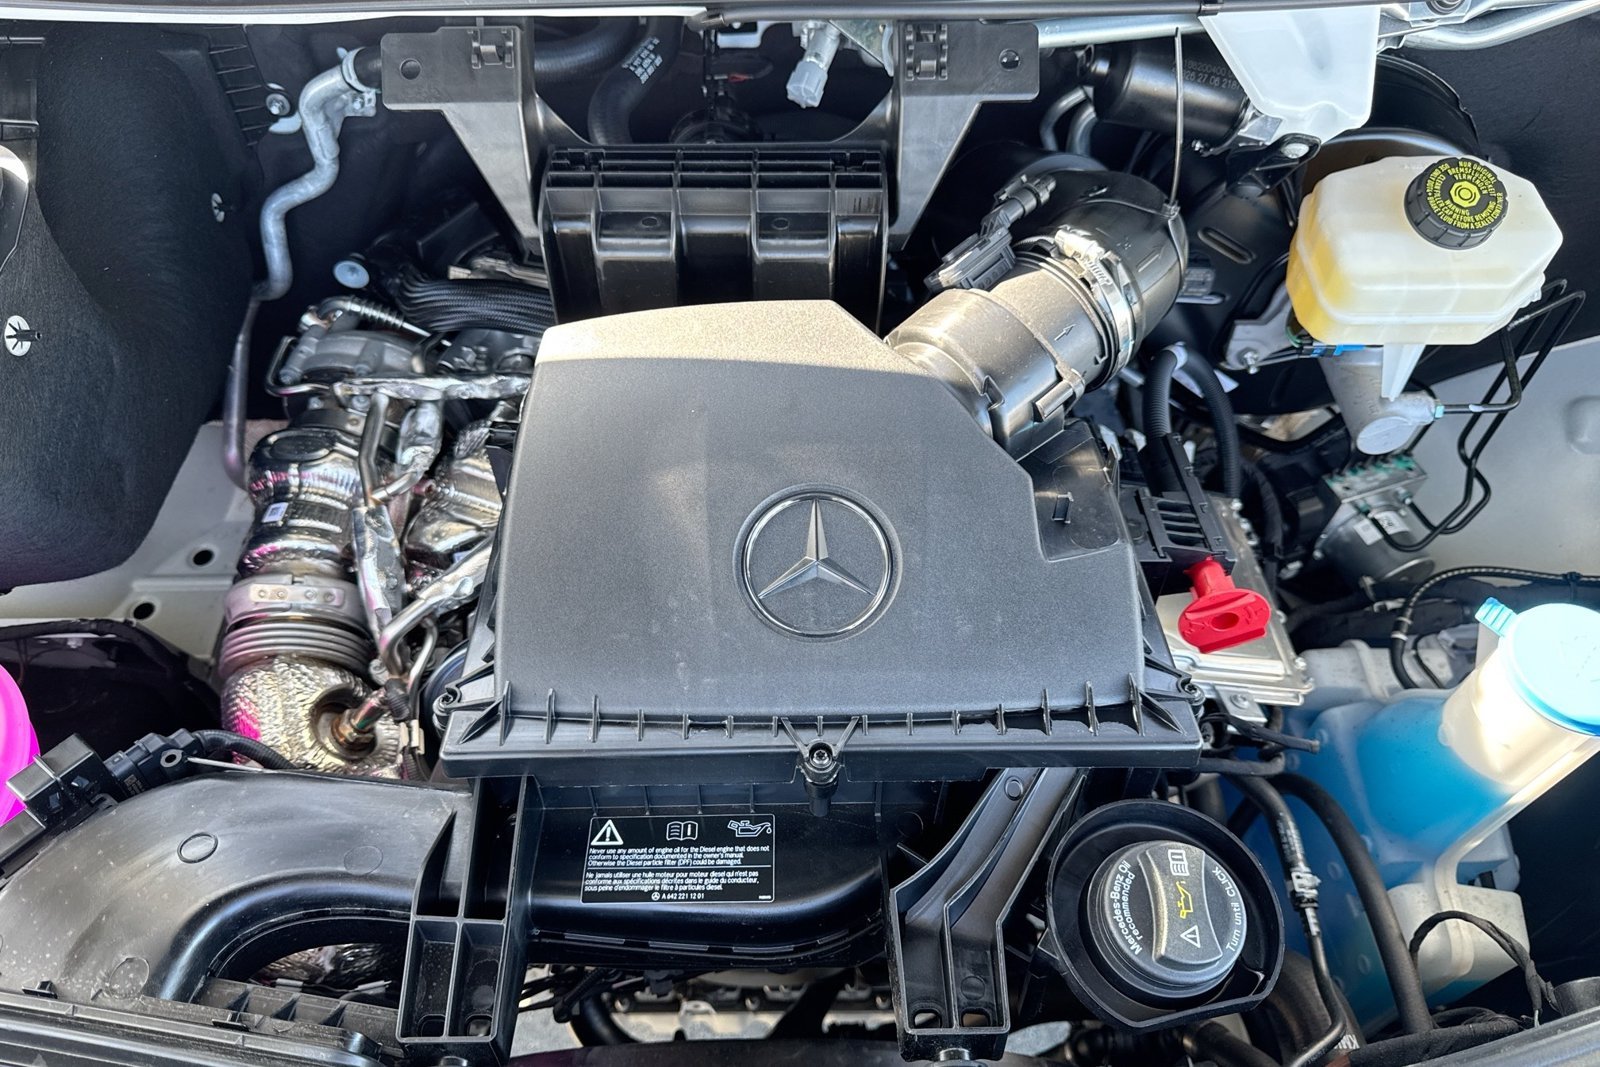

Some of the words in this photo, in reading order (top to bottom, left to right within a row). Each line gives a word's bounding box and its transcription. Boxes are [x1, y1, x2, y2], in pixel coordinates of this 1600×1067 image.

[1472, 163, 1497, 184] ORIGINAL
[1444, 200, 1470, 216] WARNING
[1118, 860, 1132, 874] Oil
[1212, 866, 1236, 897] CLICK
[1110, 874, 1142, 954] Mercedes-Benz
[1122, 871, 1143, 940] recommended
[1230, 902, 1242, 926] until
[1226, 929, 1240, 952] Turn
